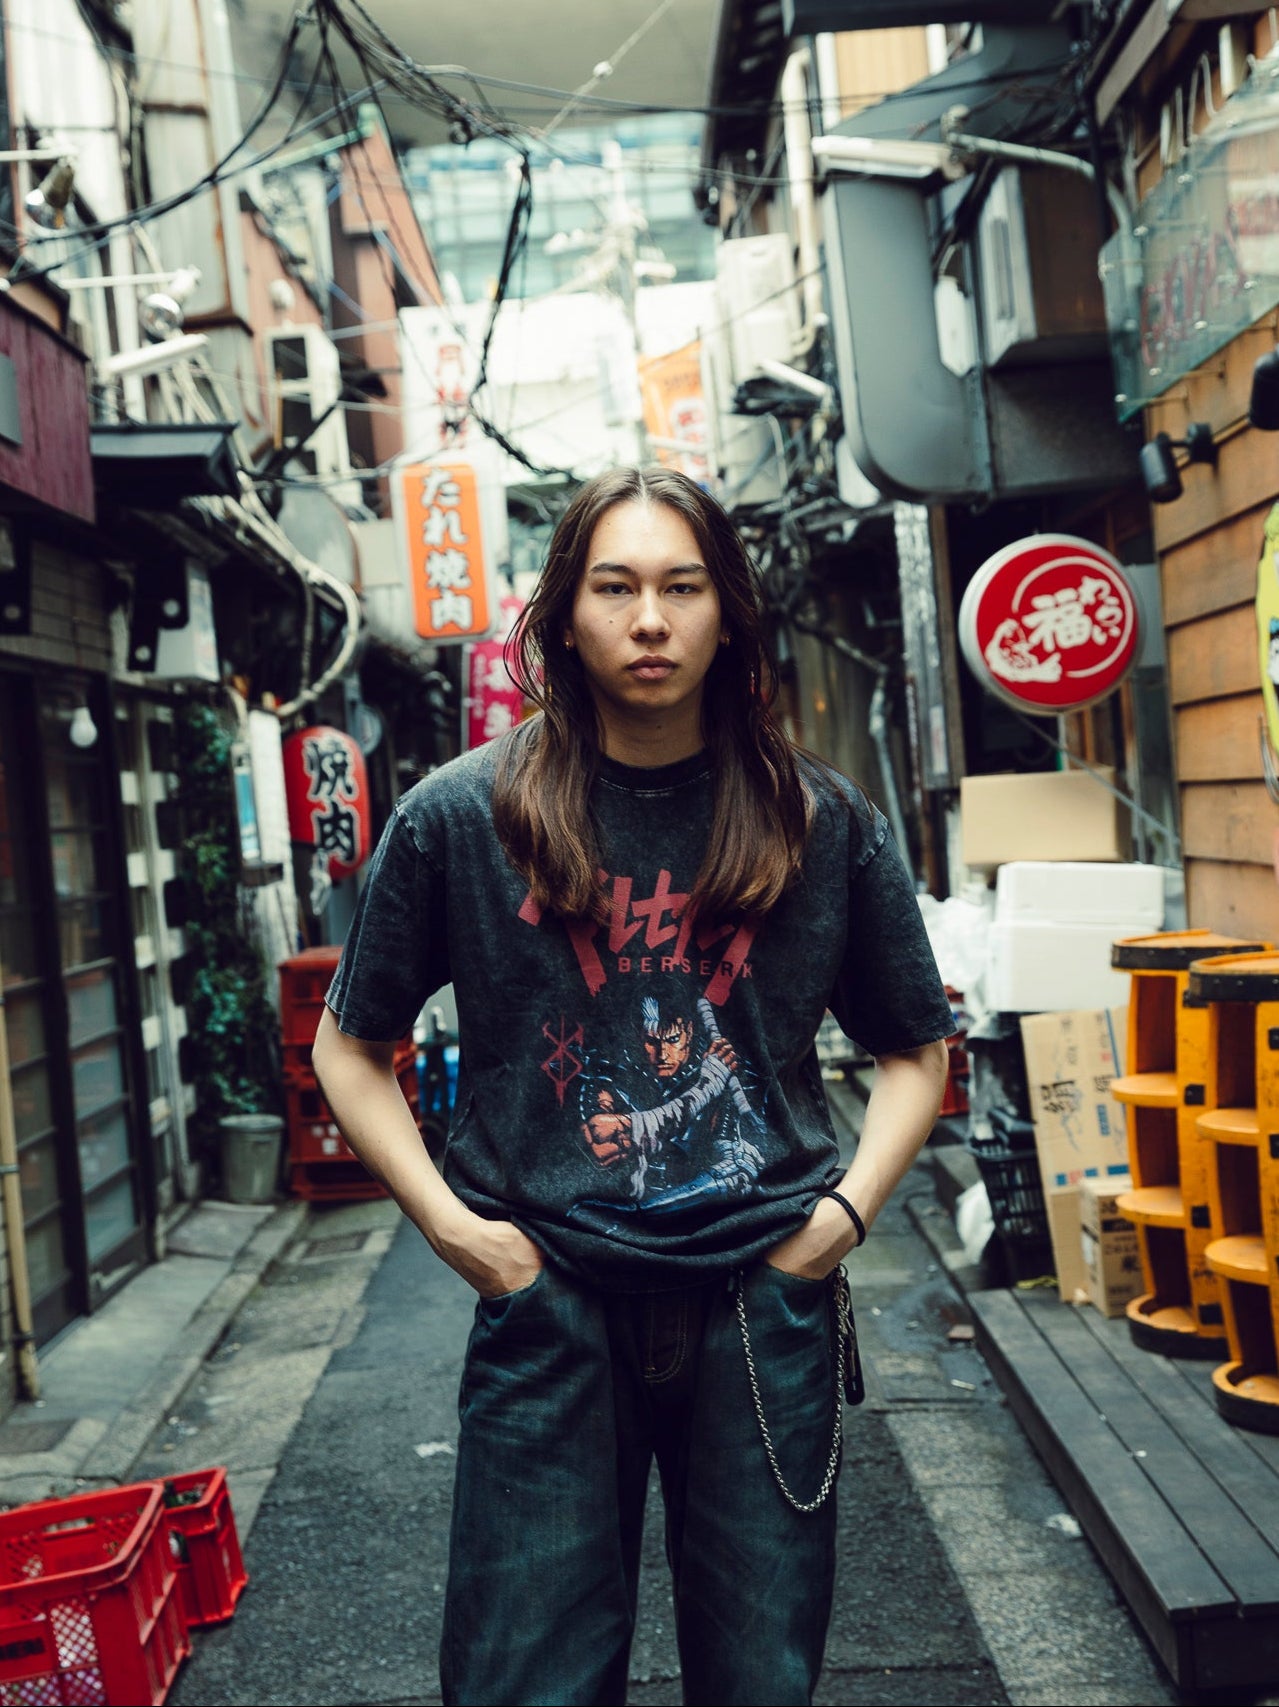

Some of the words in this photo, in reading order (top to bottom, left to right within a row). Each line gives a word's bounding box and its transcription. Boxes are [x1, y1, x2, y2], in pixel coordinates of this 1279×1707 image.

[420, 467, 473, 632] たれ焼肉
[303, 737, 360, 864] 焼肉
